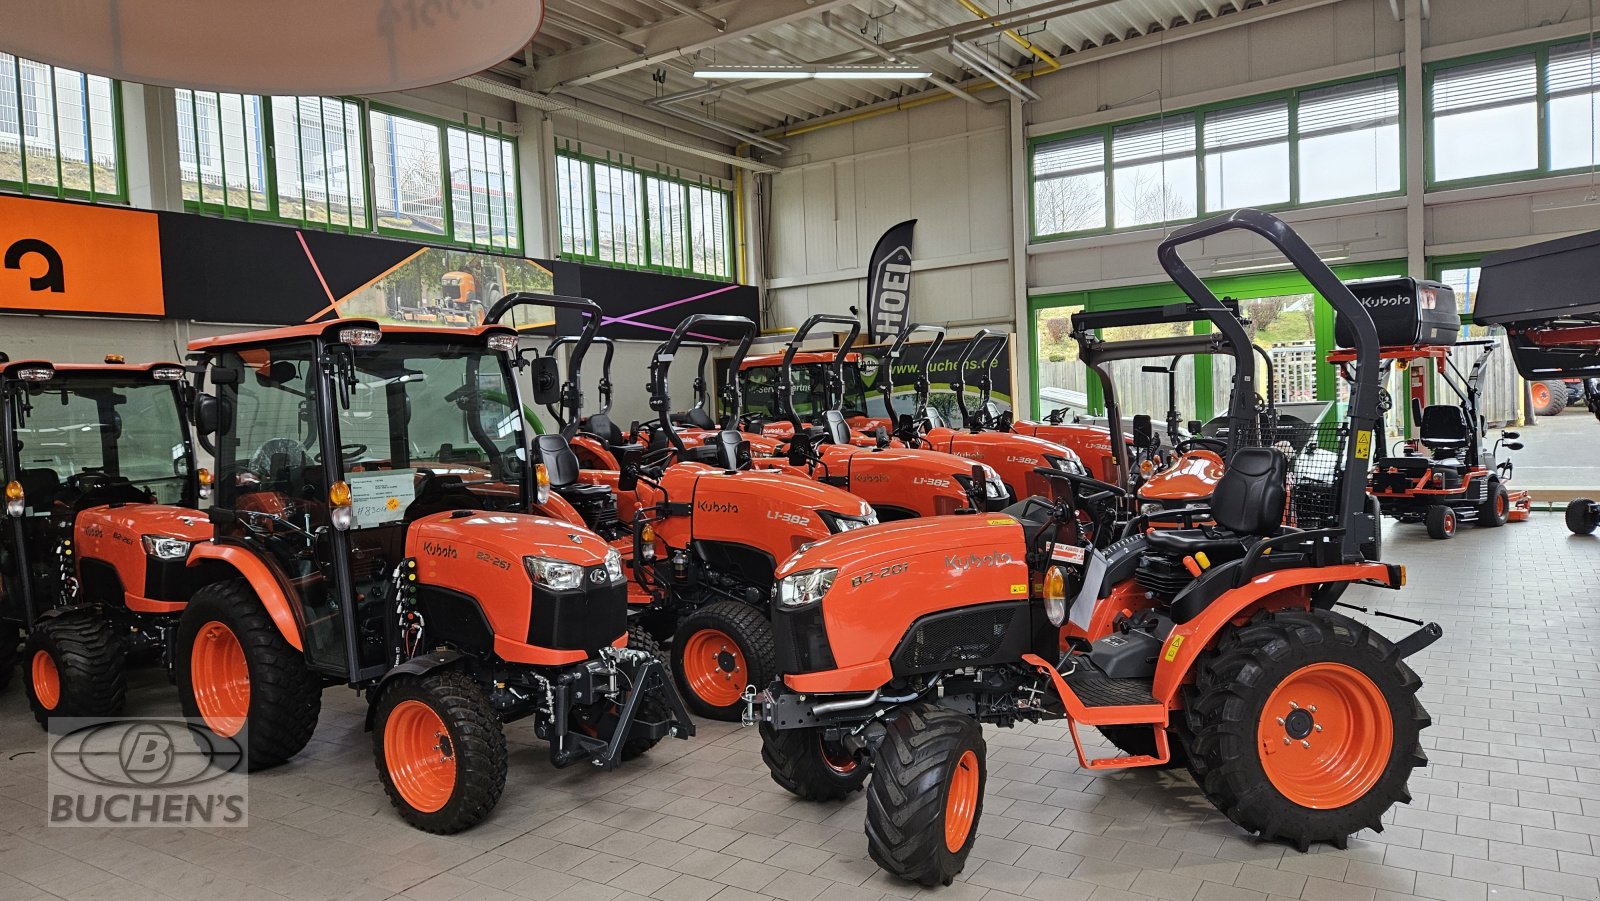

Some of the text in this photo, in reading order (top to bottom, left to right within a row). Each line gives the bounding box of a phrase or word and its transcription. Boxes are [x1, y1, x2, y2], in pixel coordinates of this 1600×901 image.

[1362, 294, 1411, 308] Kubota
[1006, 455, 1039, 466] L1-382
[913, 477, 951, 488] L1-382
[698, 500, 810, 527] Kubota L1-382
[423, 542, 458, 559] Kubota
[944, 551, 1013, 571] Kubota
